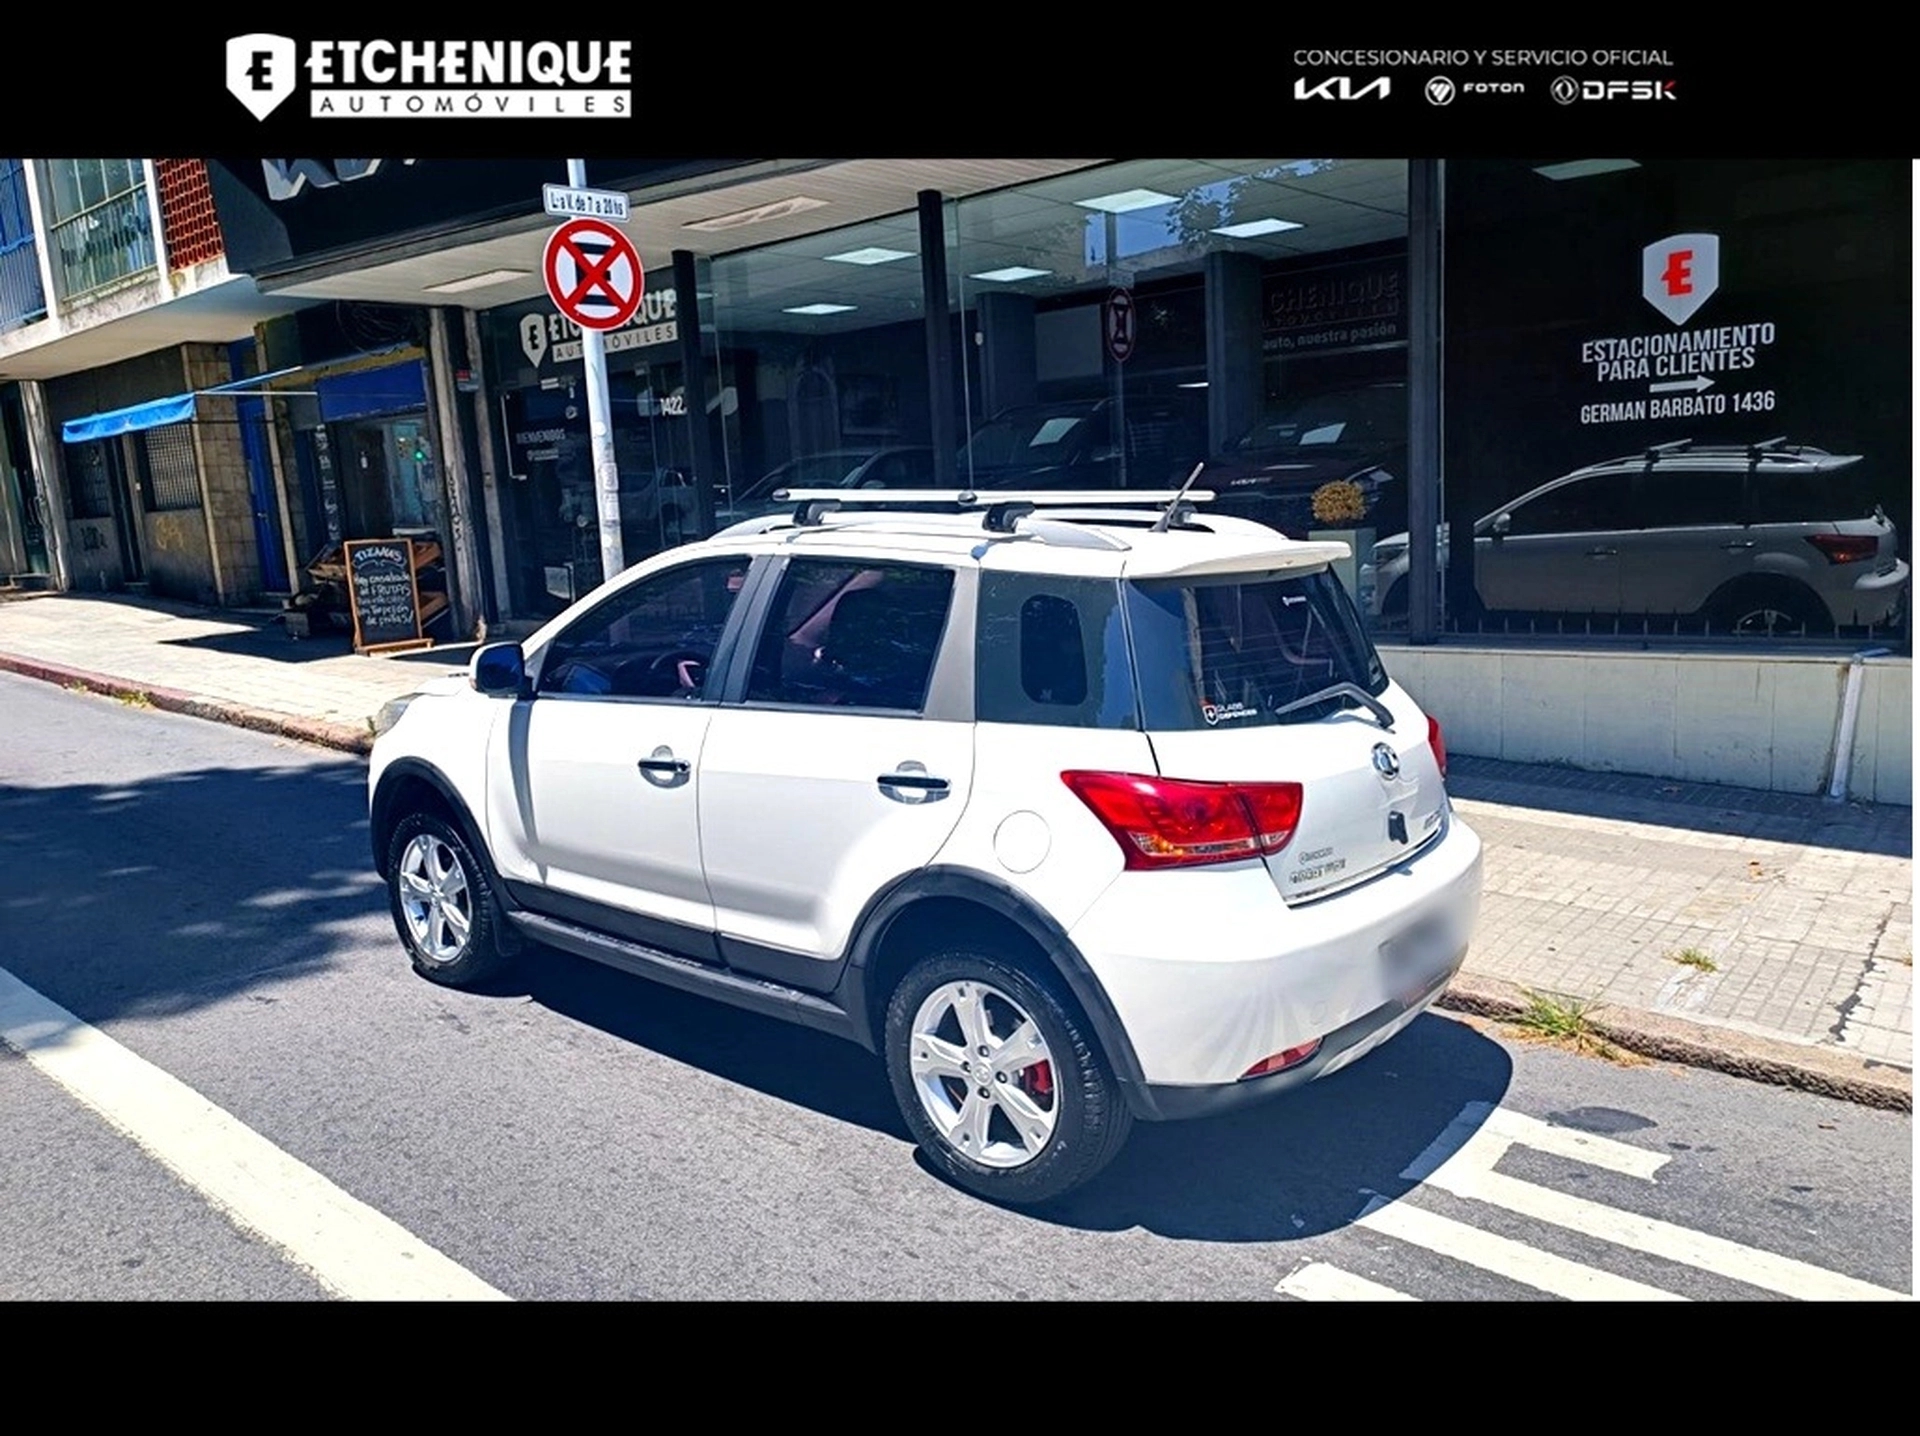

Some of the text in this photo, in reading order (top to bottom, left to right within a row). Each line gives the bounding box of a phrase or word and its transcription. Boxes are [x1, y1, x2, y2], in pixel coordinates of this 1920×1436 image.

[556, 325, 674, 359] AUTÓVILES
[1297, 328, 1348, 347] nuestra
[1350, 321, 1397, 343] pasión
[1582, 322, 1775, 363] ESTACIONAMIENTO
[1597, 347, 1756, 382] PARA CLIENTES
[1580, 390, 1776, 424] GERMAN BARBATO 1436
